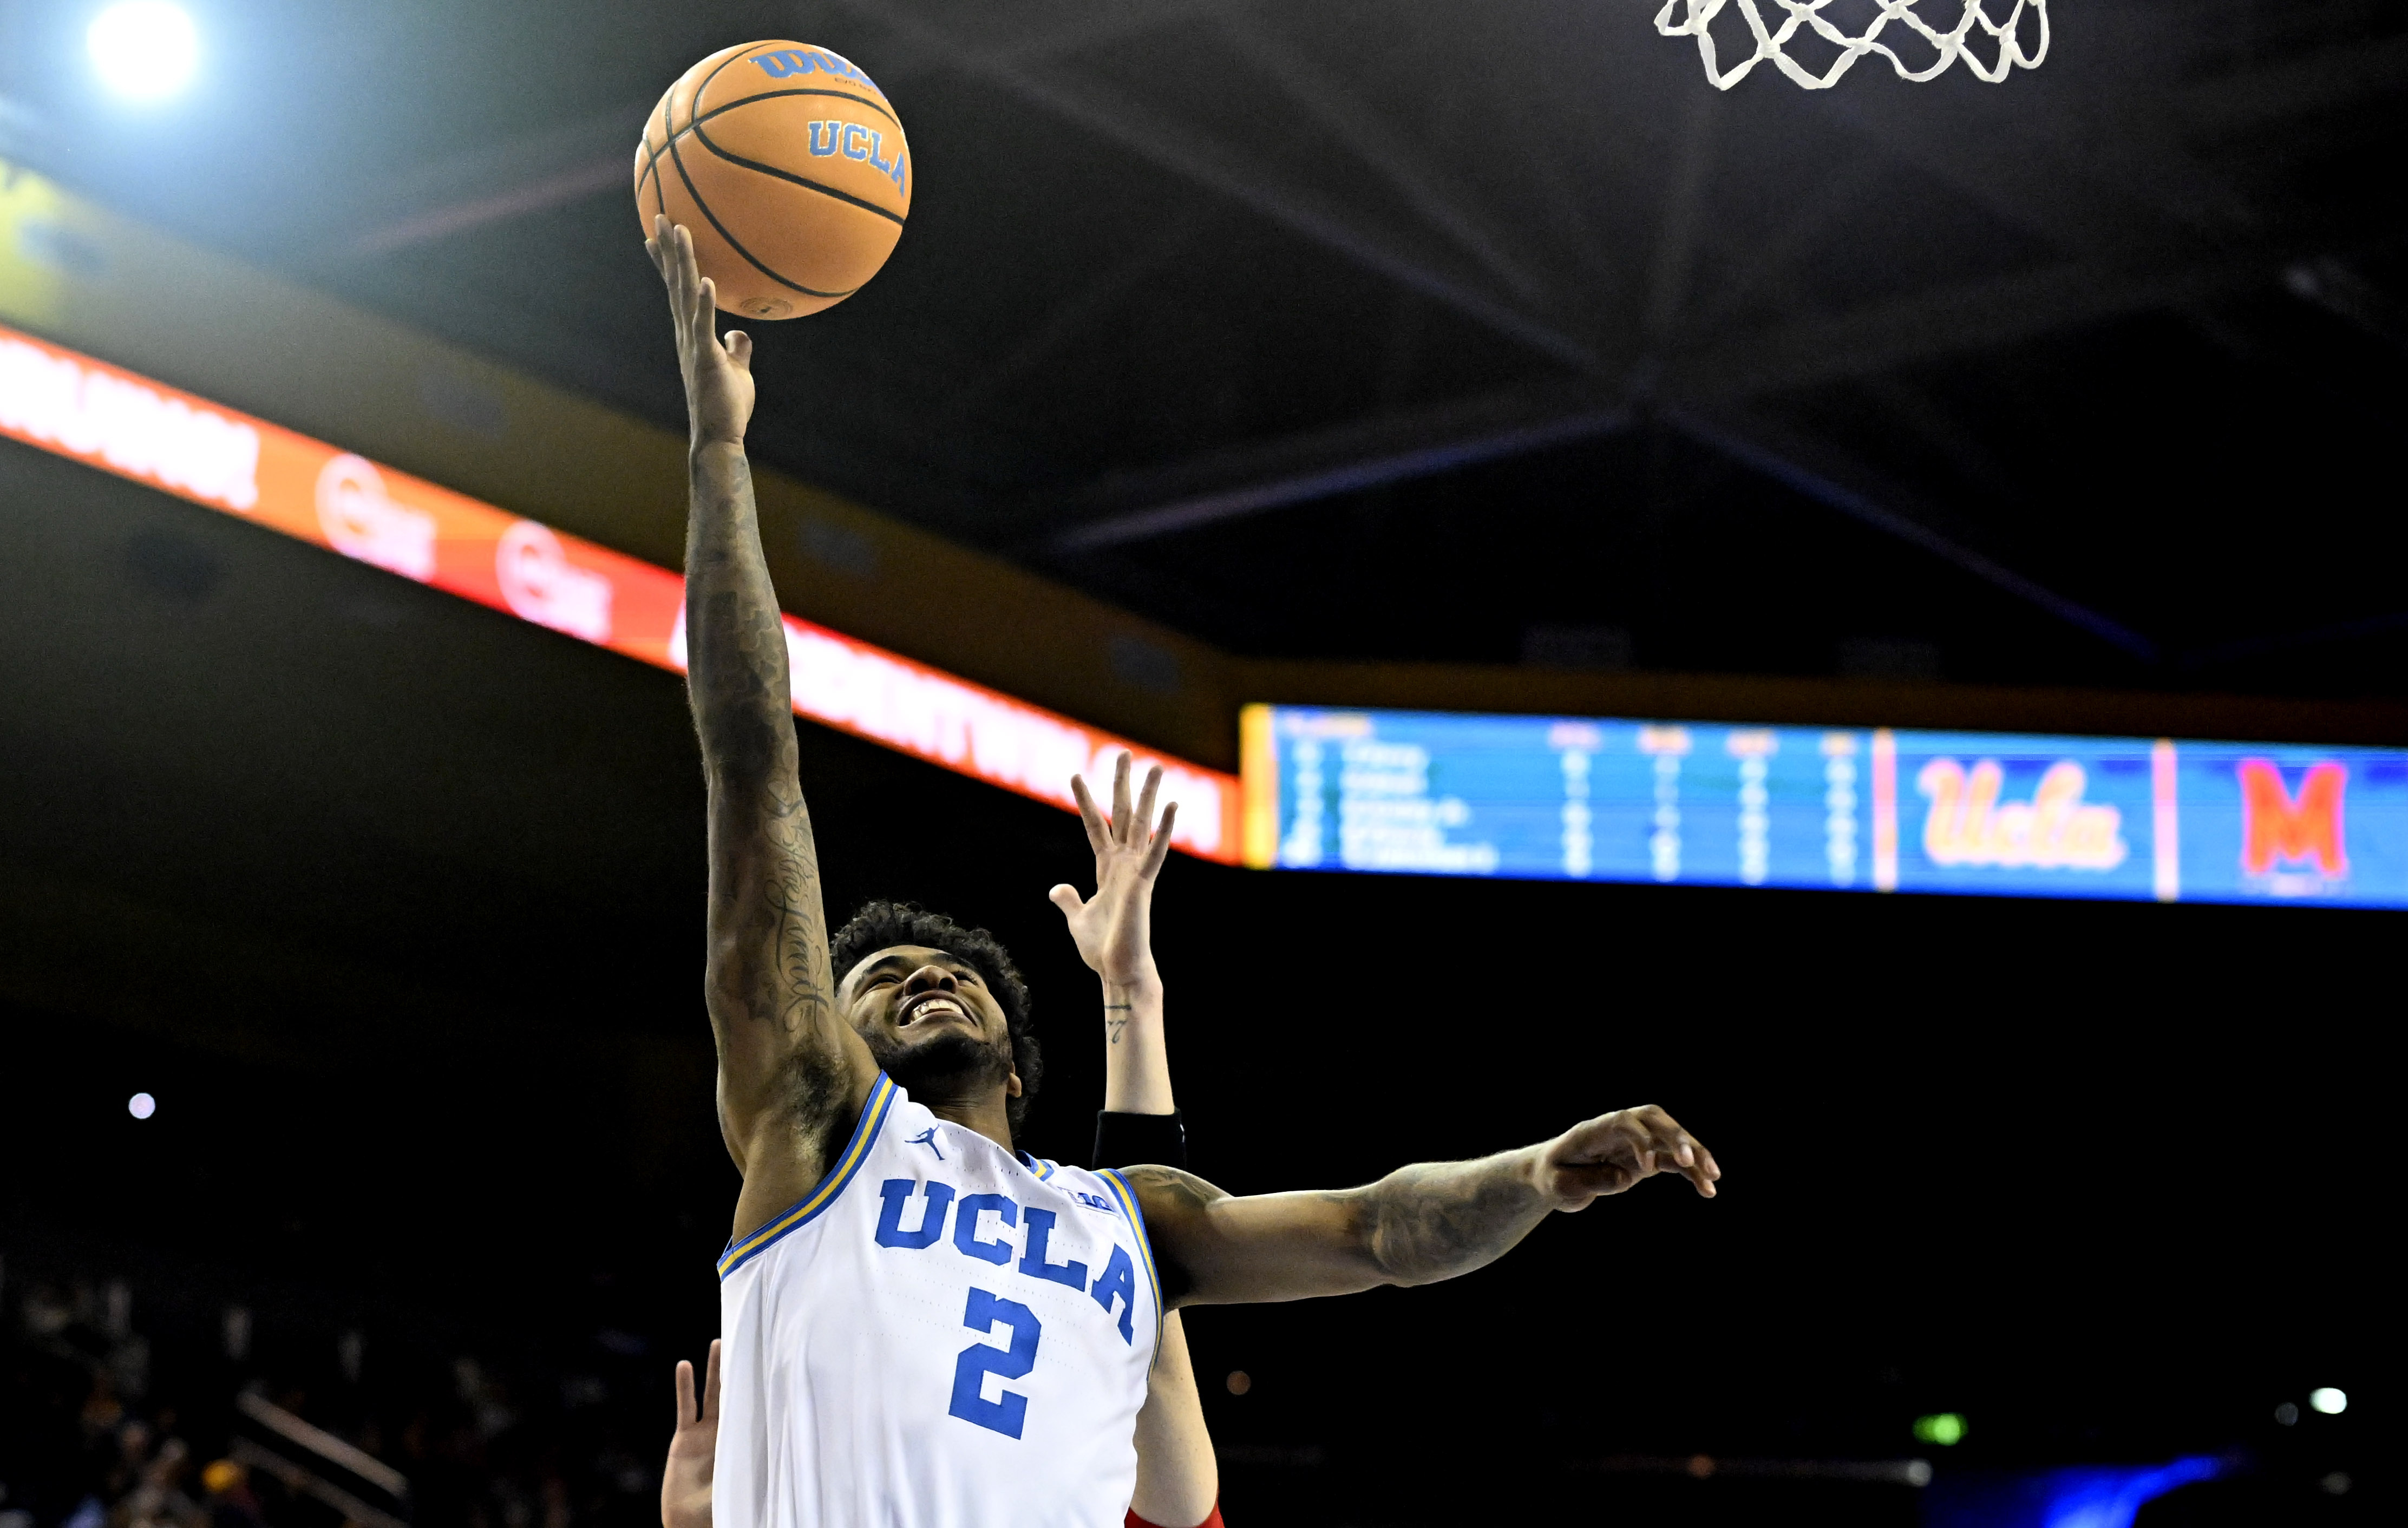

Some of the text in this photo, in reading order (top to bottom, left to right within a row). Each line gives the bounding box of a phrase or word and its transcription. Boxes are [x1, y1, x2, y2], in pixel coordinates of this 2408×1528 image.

[808, 120, 905, 198] UCLA
[2240, 759, 2348, 878] M
[874, 1178, 1135, 1347] UCLA
[948, 1286, 1042, 1441] 2
